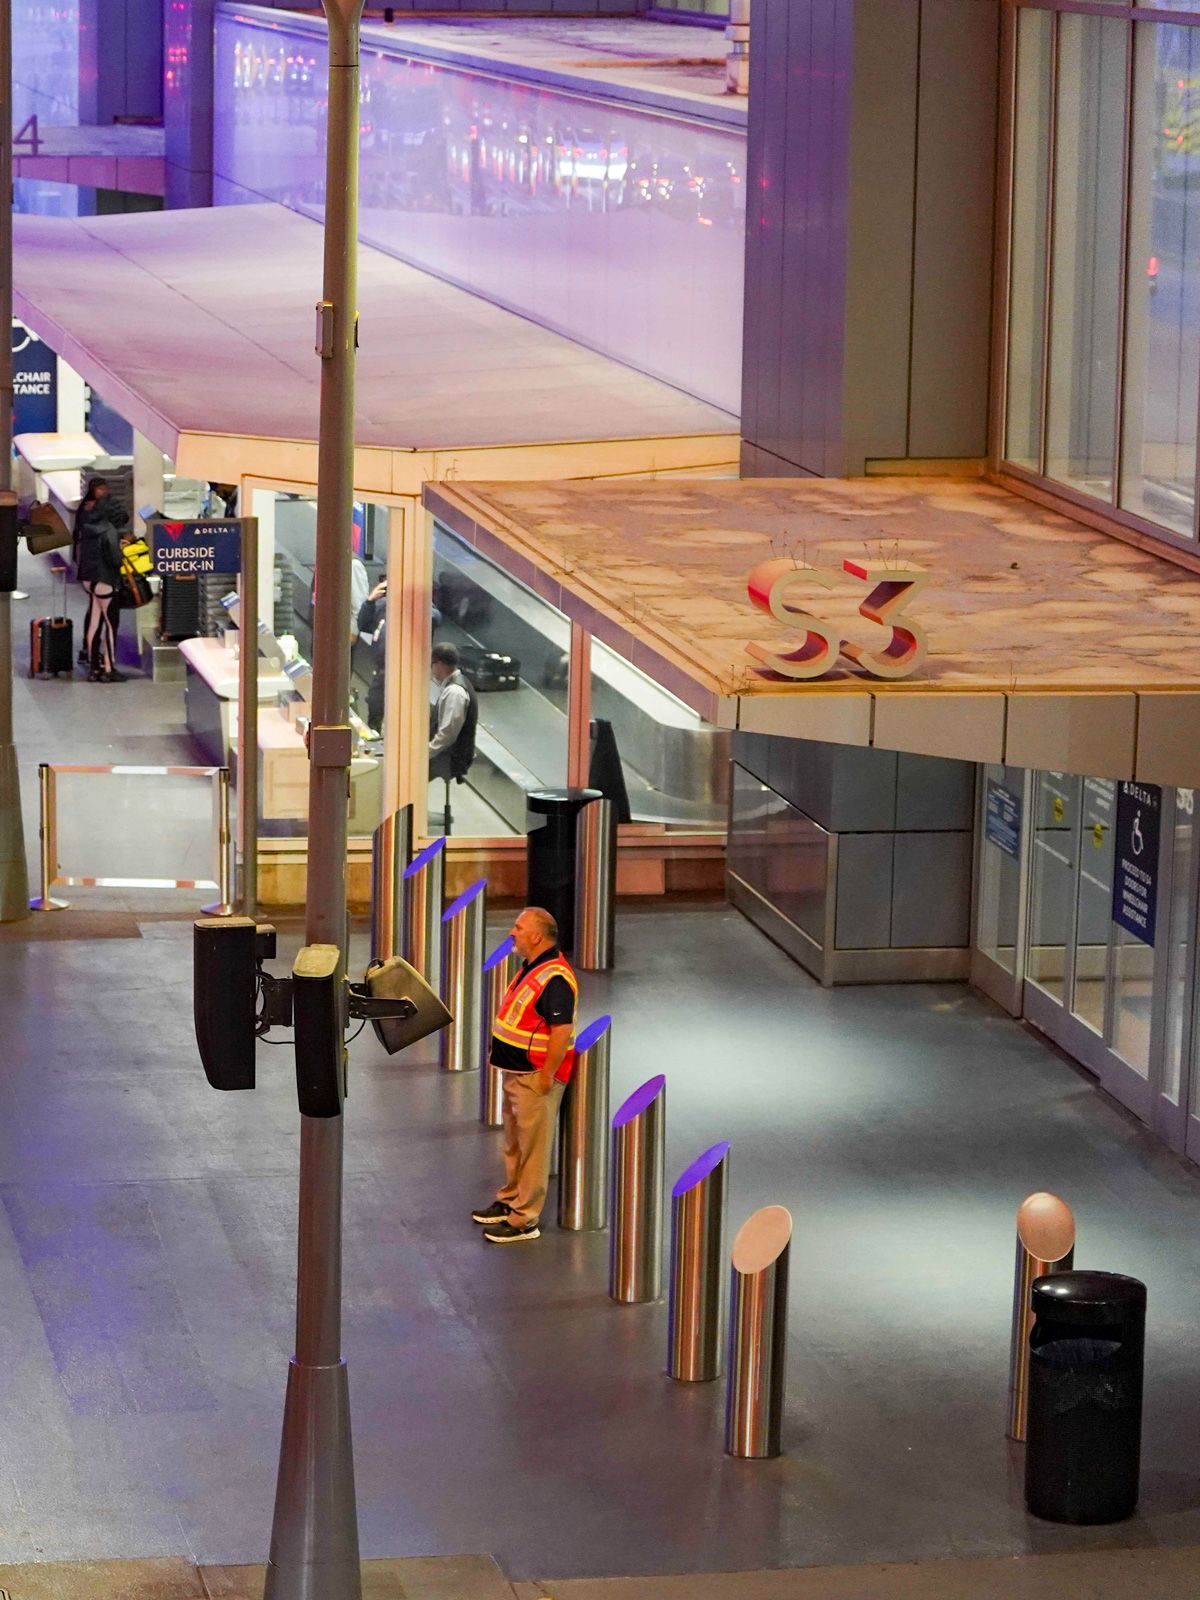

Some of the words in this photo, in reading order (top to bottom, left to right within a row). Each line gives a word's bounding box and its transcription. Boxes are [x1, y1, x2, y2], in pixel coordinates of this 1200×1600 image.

[157, 547, 215, 559] CURBSIDE
[157, 560, 214, 572] CHECK-IN
[744, 557, 929, 679] S3
[1129, 783, 1152, 806] DELTA
